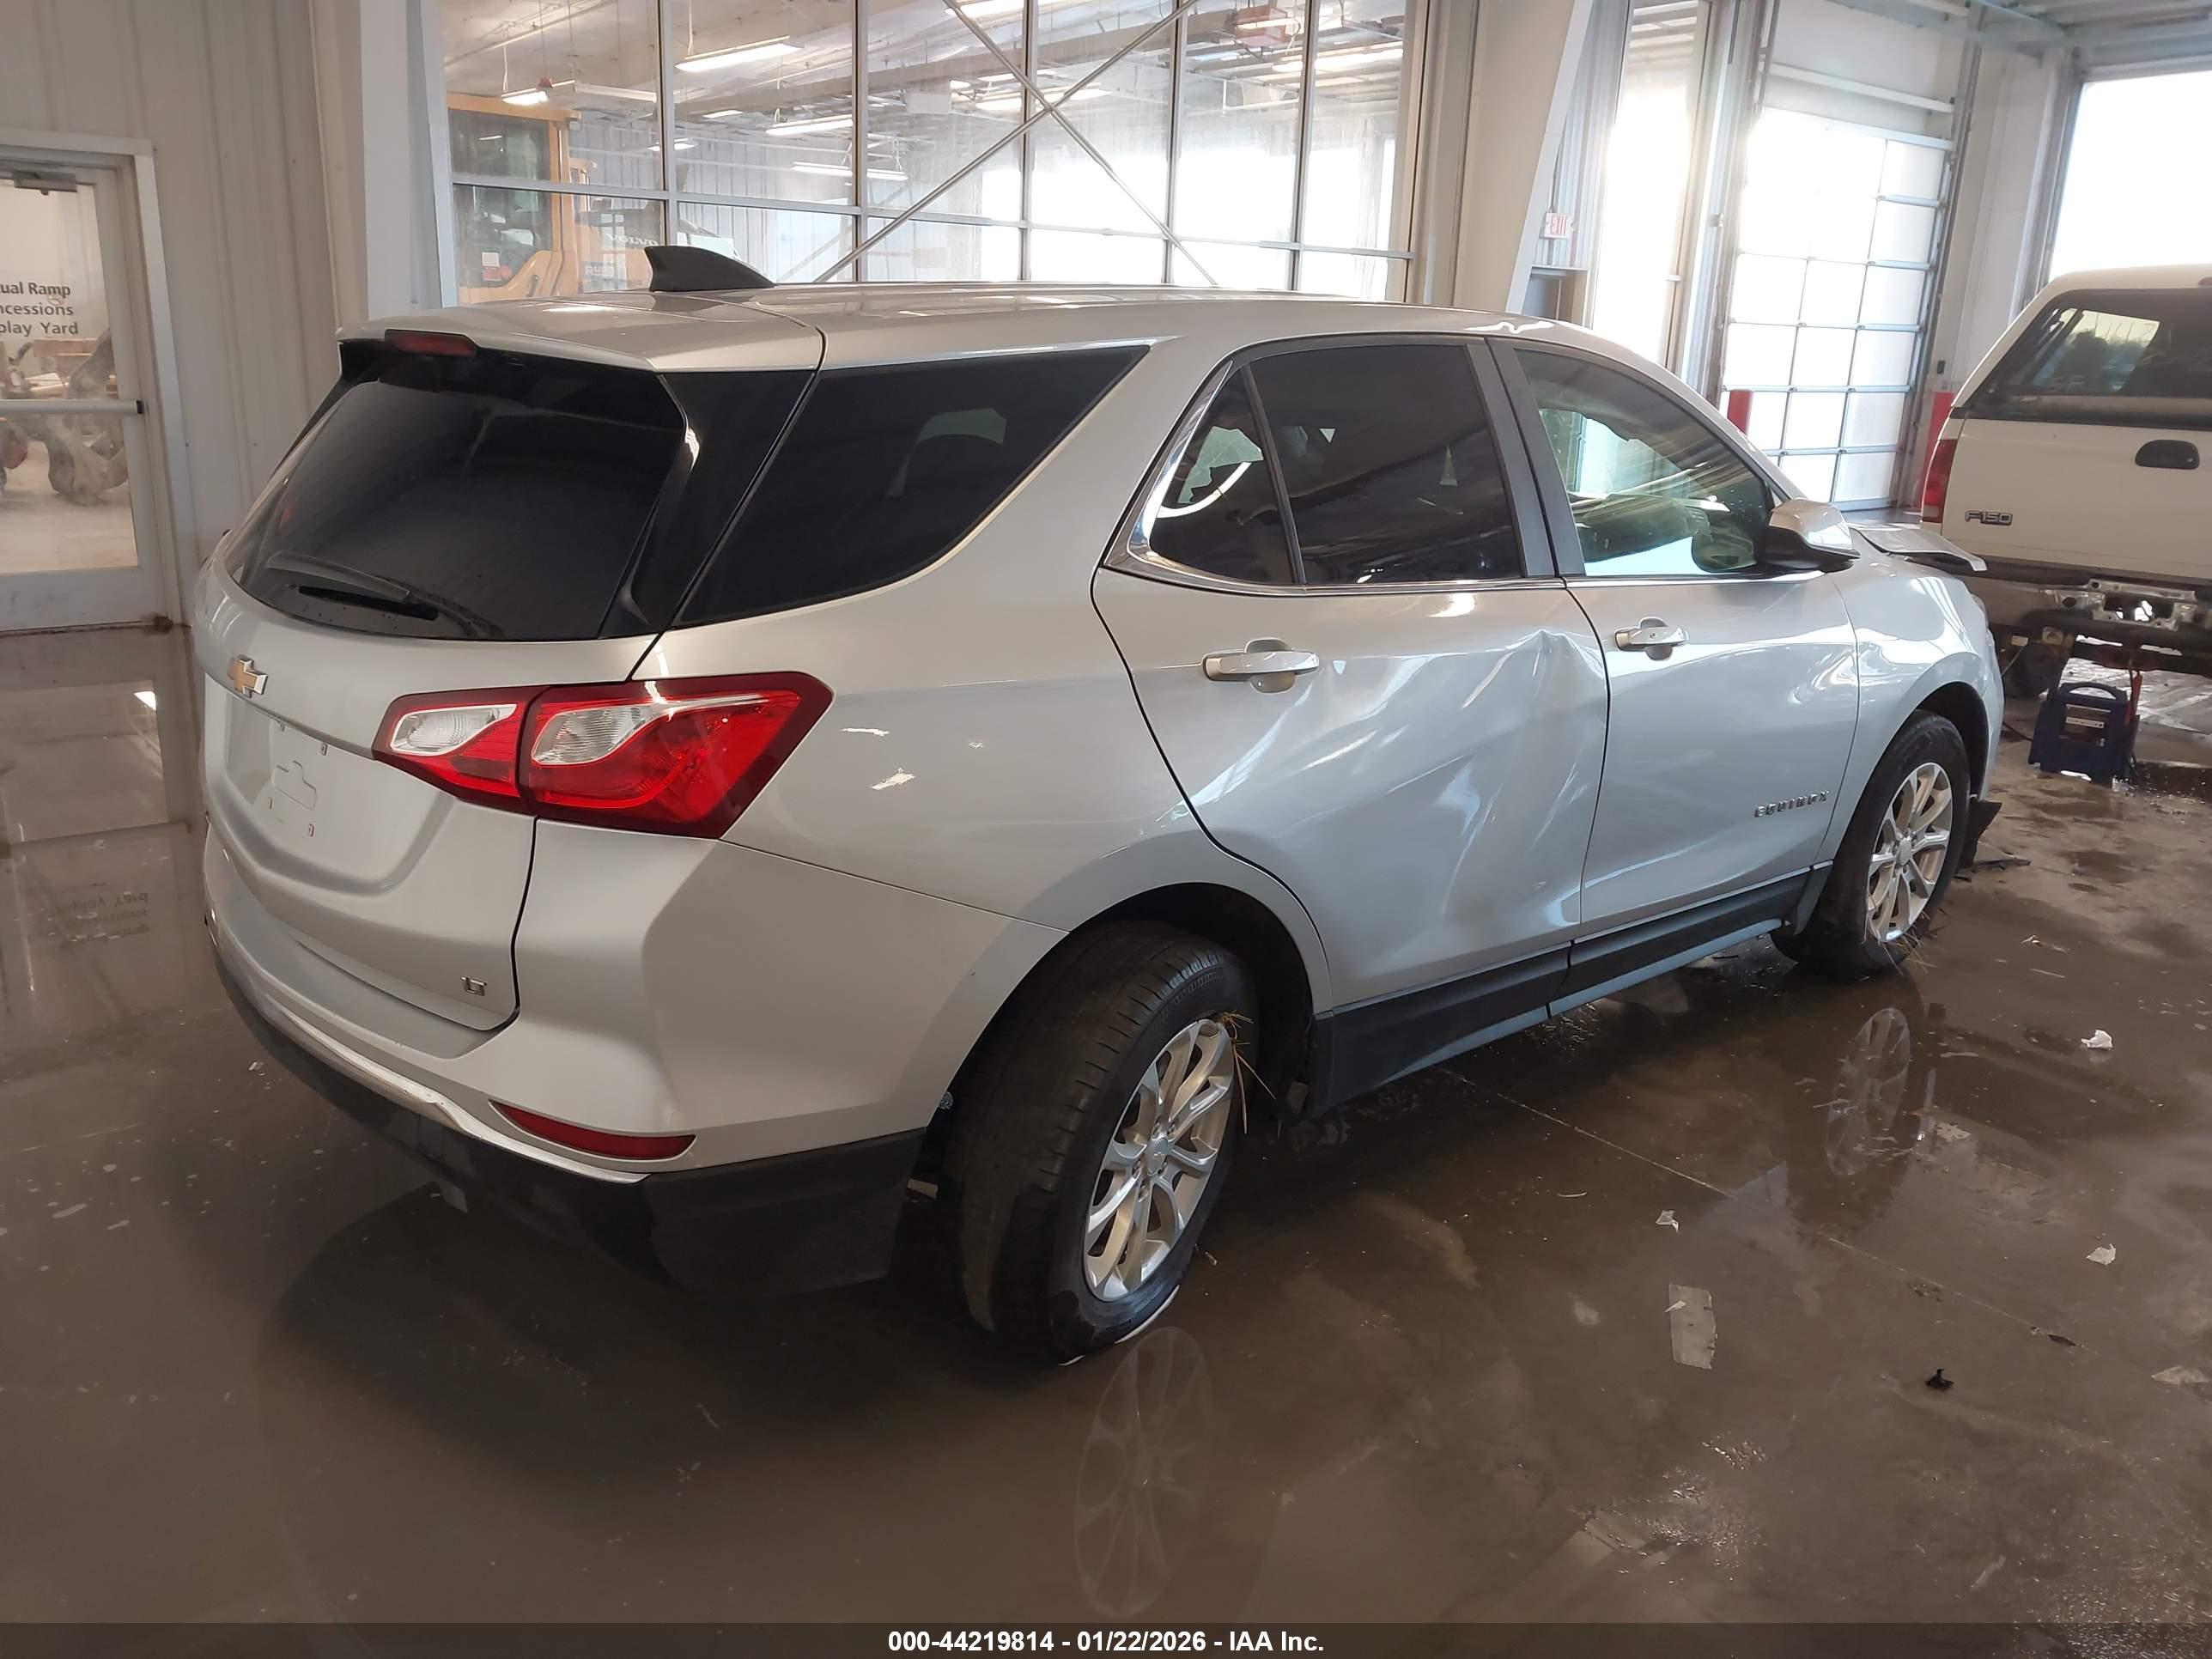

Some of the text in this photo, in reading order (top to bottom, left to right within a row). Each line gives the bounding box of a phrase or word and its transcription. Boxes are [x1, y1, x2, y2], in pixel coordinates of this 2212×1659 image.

[0, 281, 71, 299] ual Ramp
[40, 321, 78, 335] Yard
[461, 976, 487, 996] LT
